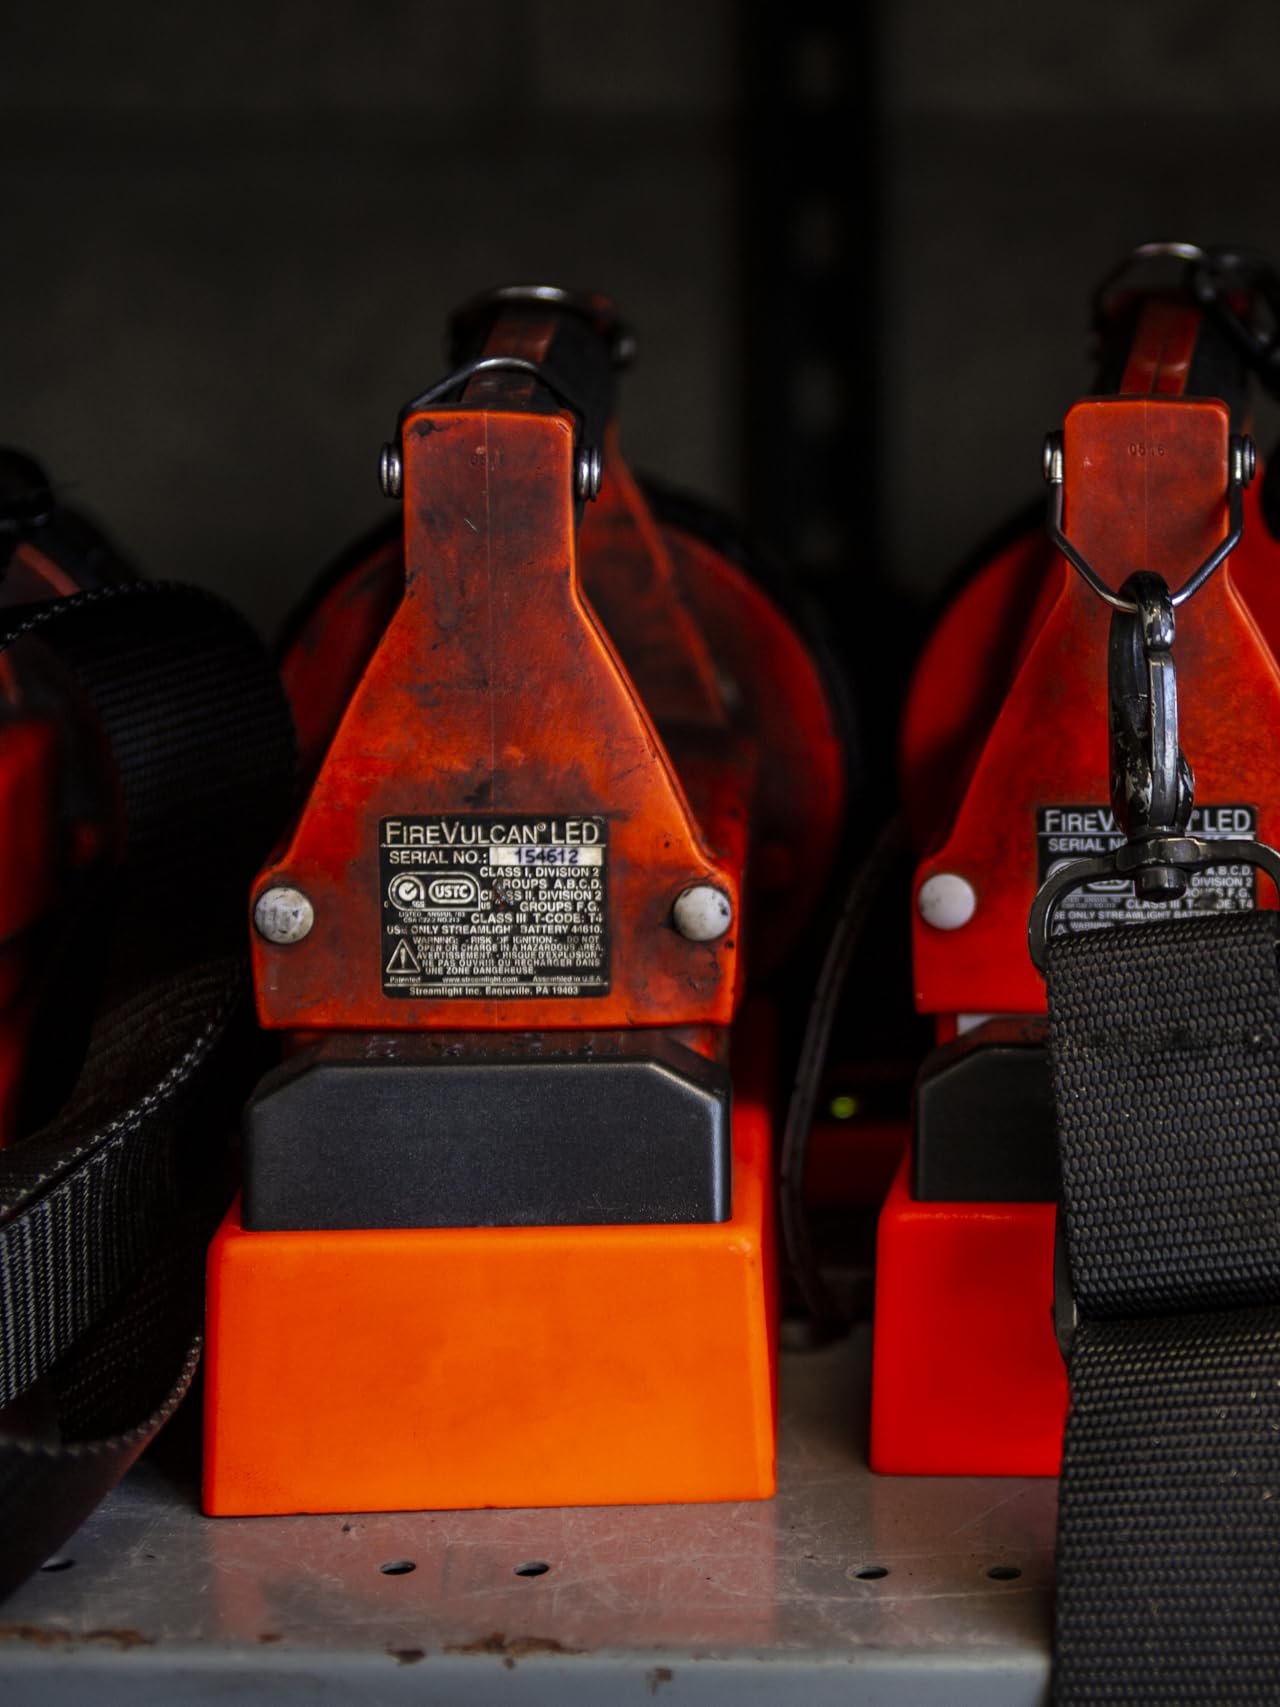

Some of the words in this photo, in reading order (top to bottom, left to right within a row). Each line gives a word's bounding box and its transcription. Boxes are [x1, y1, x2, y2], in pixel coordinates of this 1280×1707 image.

[1204, 809, 1251, 832] LED
[551, 821, 599, 844] LED
[1048, 838, 1105, 852] SERIAL
[389, 850, 448, 864] SERIAL
[514, 848, 579, 864] 154612
[480, 867, 522, 878] CLASS
[535, 866, 589, 878] DIVISION
[592, 866, 600, 878] 2
[1191, 877, 1243, 887] DIVISION
[1246, 877, 1253, 887] 2
[434, 885, 469, 898] USTC
[538, 890, 592, 900] DIVISION
[594, 890, 602, 901] 2
[520, 901, 573, 912] GROUPS
[1126, 899, 1167, 909] CLASS
[471, 913, 513, 924] CLASS
[516, 913, 527, 924] III
[588, 913, 603, 923] T4
[1068, 911, 1095, 919] ONLY
[1098, 910, 1171, 920] STREAMLIGHT
[411, 925, 439, 934] ONLY
[471, 936, 492, 944] RISK
[513, 936, 553, 944] IGNITION
[417, 944, 442, 952] OPEN
[410, 987, 462, 997] Streamlight
[552, 987, 579, 995] 19403
